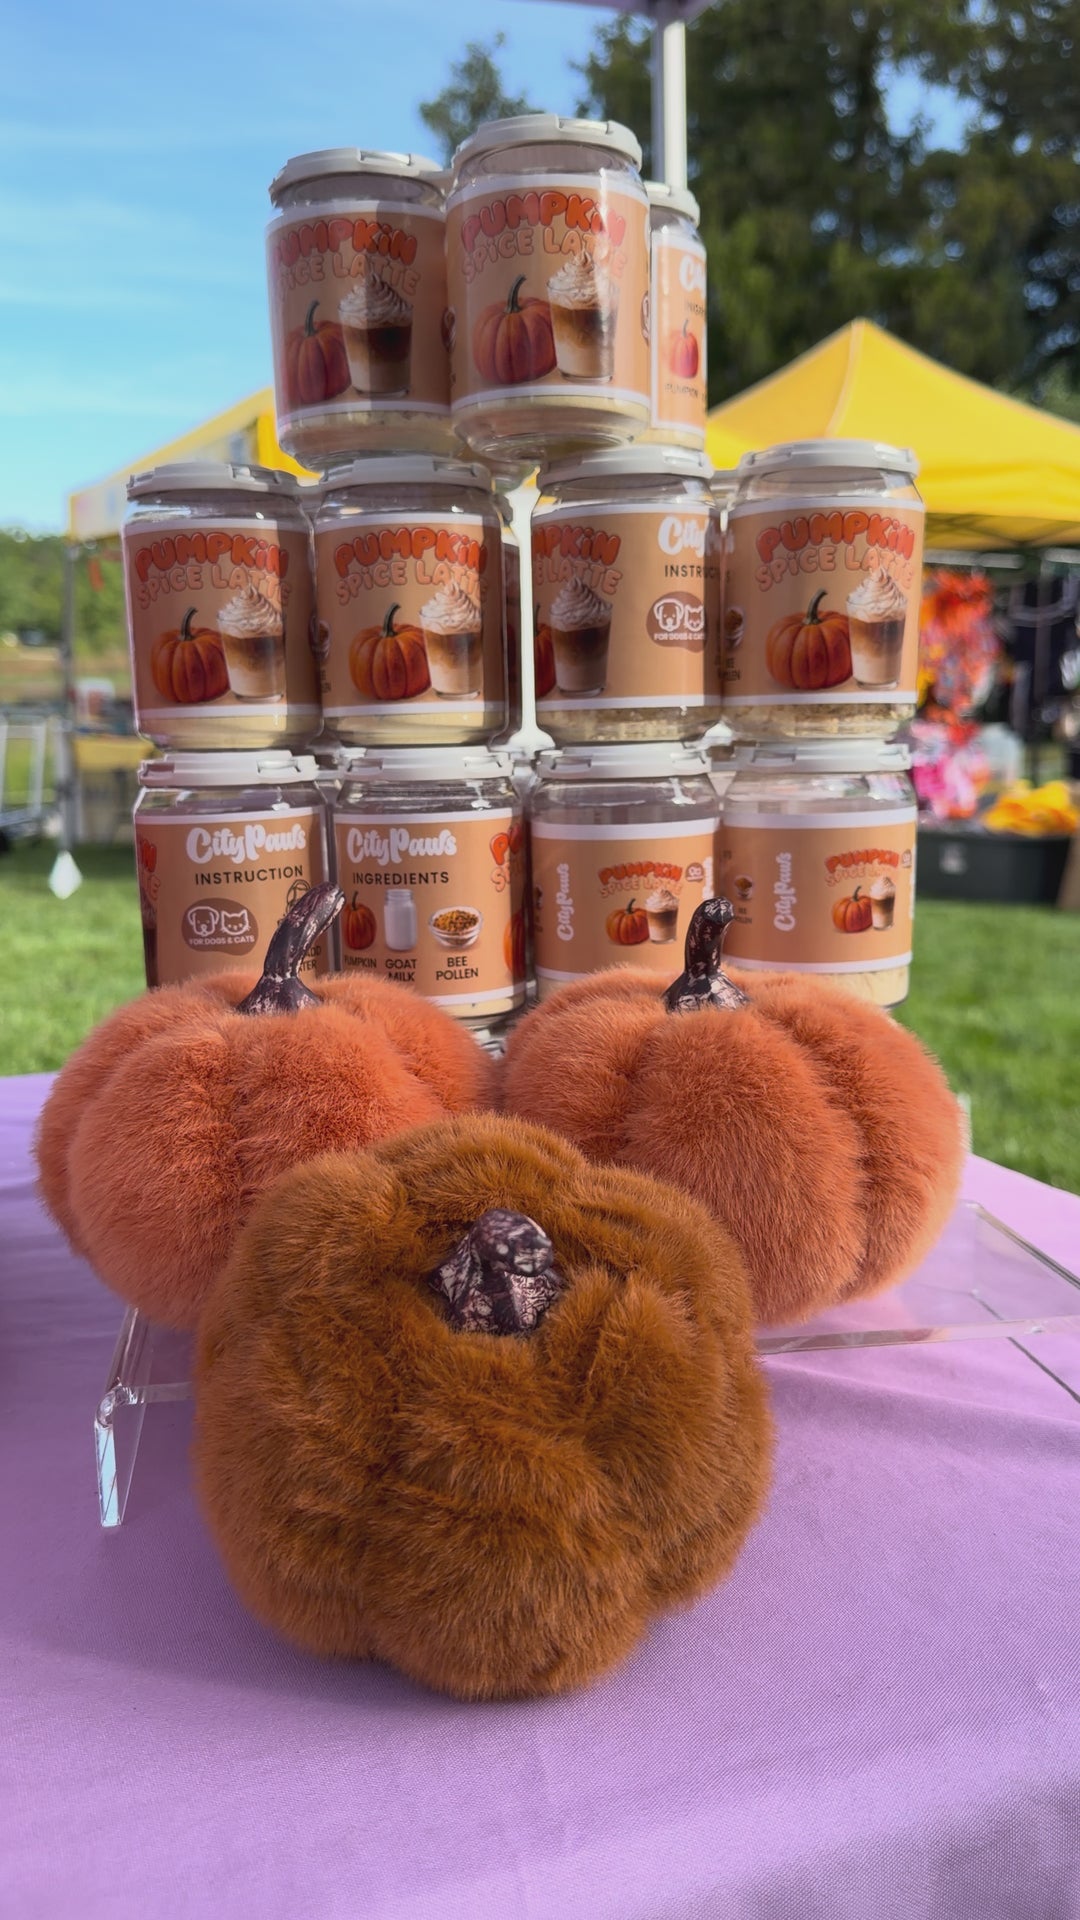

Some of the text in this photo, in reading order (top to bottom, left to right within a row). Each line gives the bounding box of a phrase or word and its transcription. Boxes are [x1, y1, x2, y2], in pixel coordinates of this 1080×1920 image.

[186, 823, 306, 864] CityPaws
[347, 828, 457, 866] CityPaws
[195, 865, 304, 886] INSTRUCTION
[353, 871, 449, 886] INGREDIENTS
[189, 936, 203, 945] FOR
[205, 936, 226, 945] DOGS
[234, 934, 255, 944] CATS
[385, 958, 417, 970] GOAT
[447, 956, 468, 968] BEE
[387, 972, 415, 982] MILK
[436, 968, 479, 981] POLLEN
